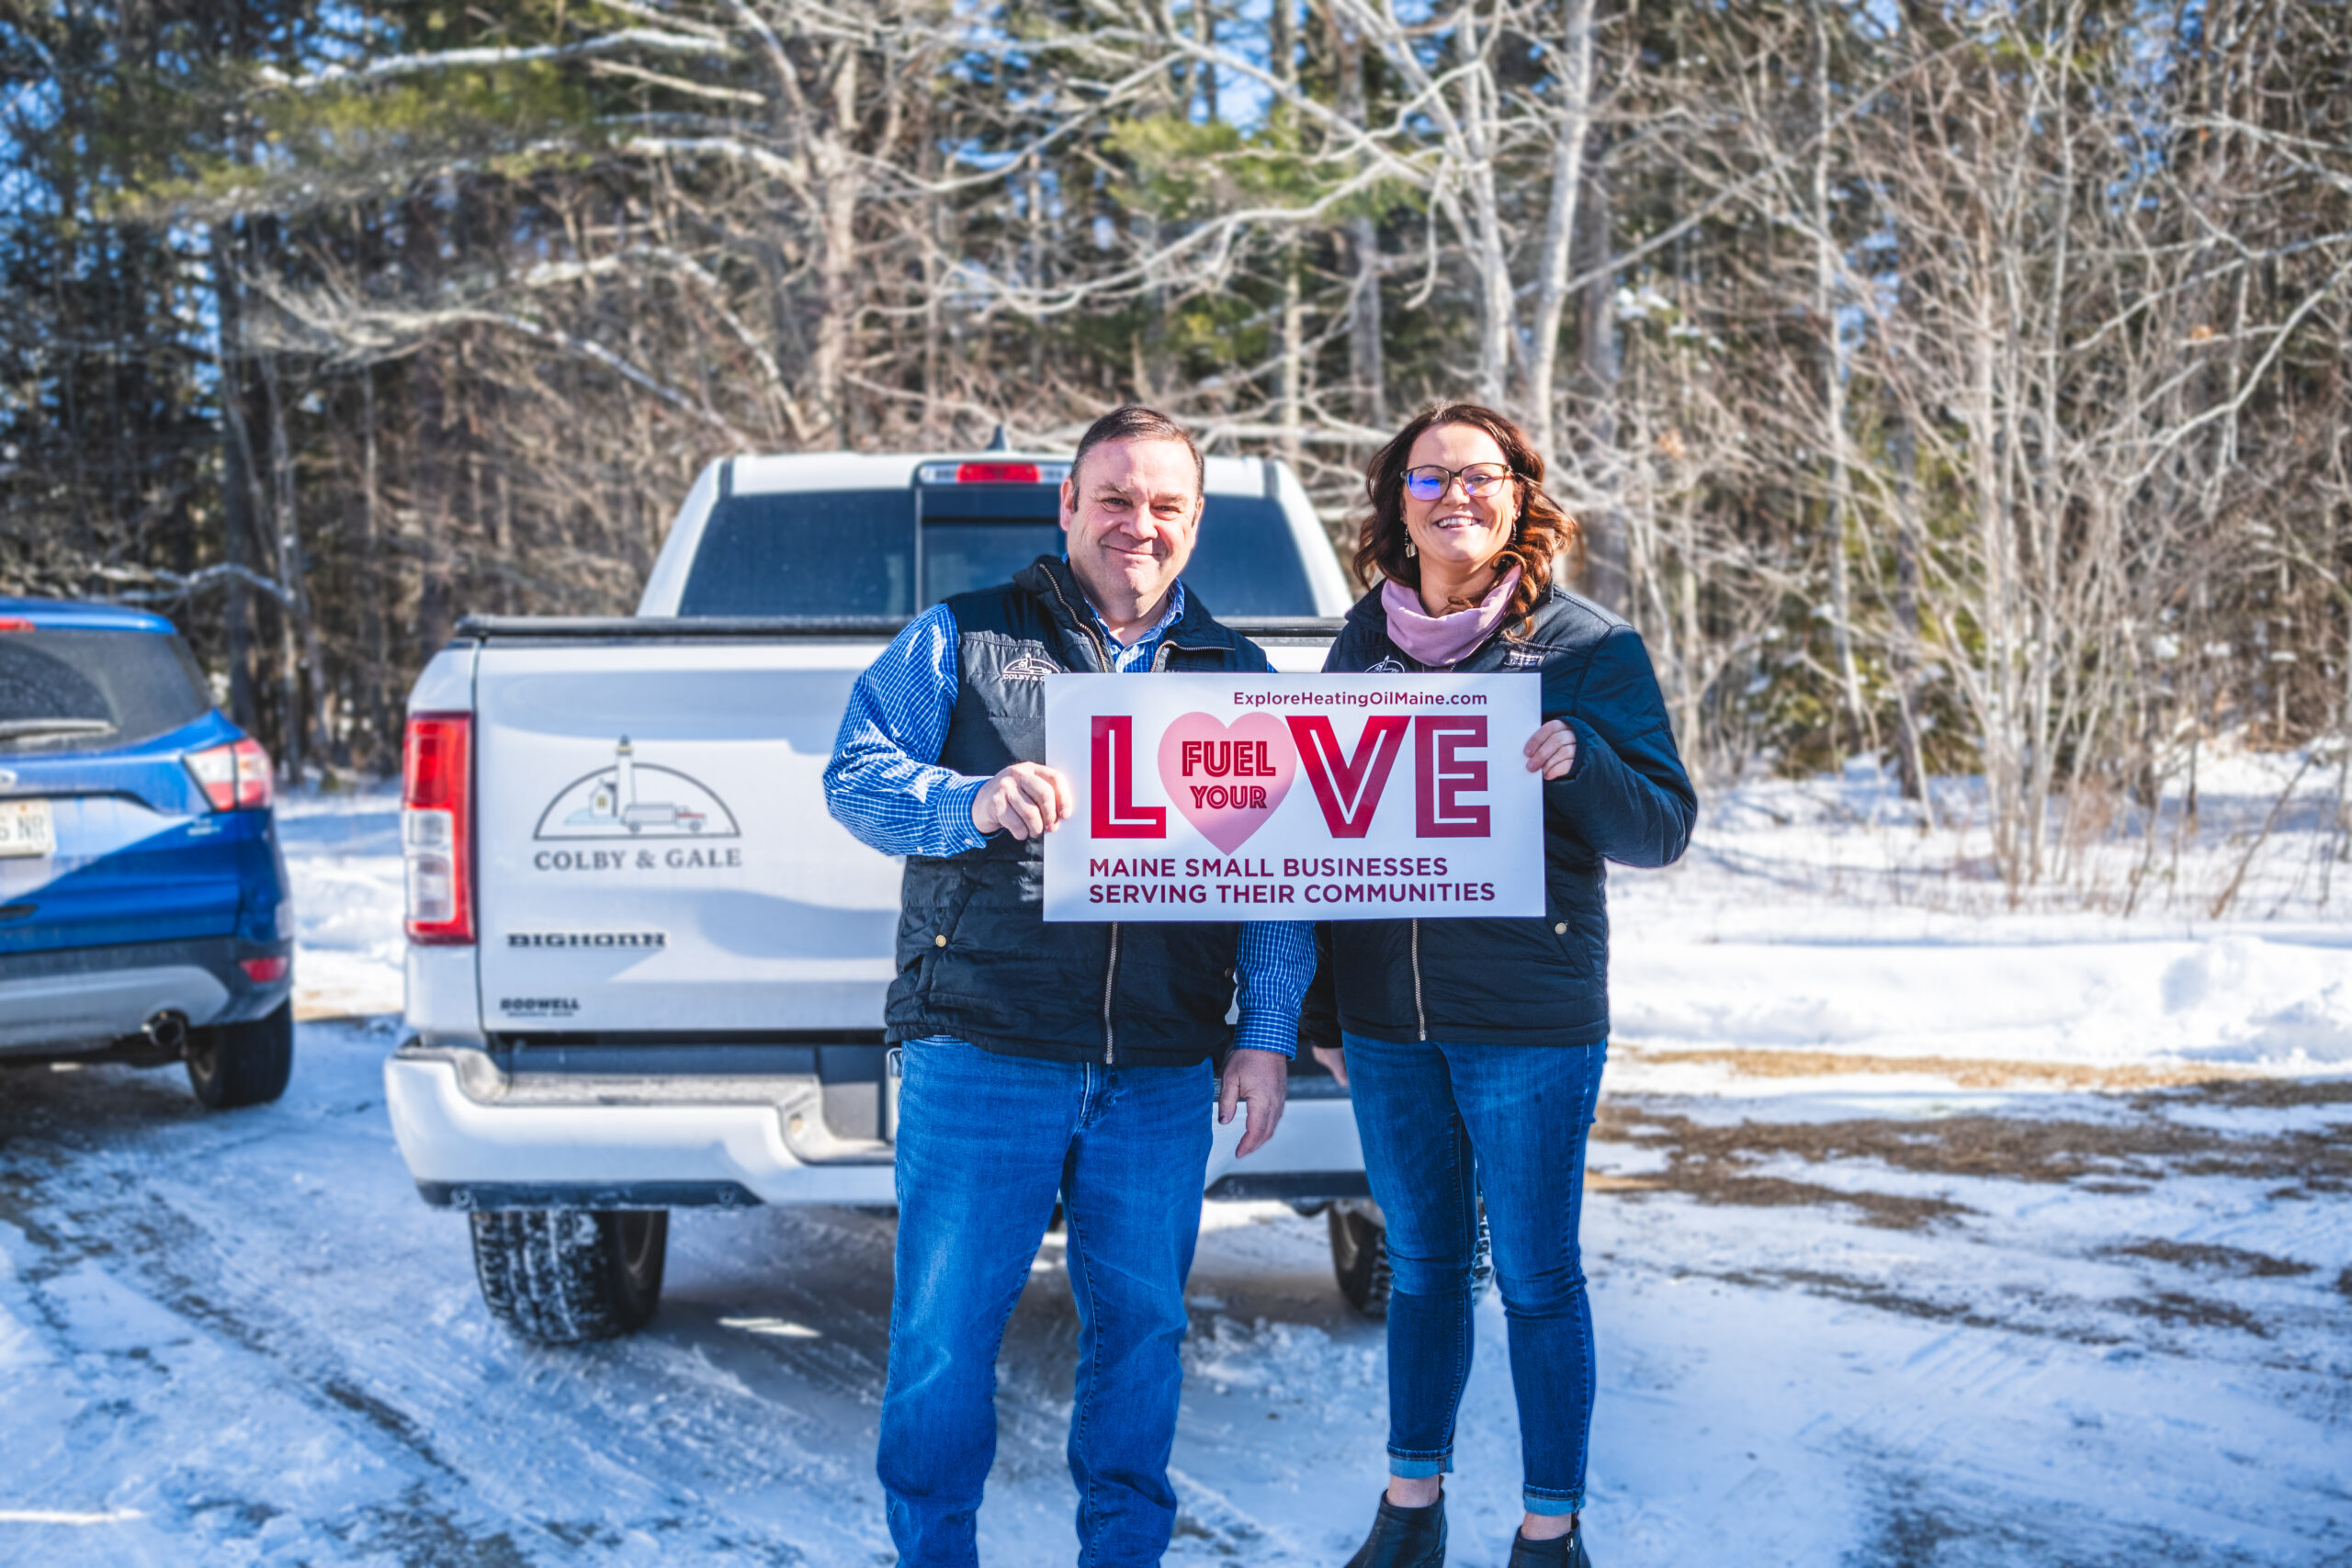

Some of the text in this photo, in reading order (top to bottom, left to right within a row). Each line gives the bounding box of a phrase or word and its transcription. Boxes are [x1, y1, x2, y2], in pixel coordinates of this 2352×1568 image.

[1234, 691, 1487, 706] ExploreHeatingOilMaine.com
[1182, 740, 1277, 777] FUEL
[1189, 784, 1268, 810] YOUR
[533, 847, 742, 872] COLBY & GALE
[1090, 857, 1448, 877] MAINE SMALL BUSINESSES
[1090, 883, 1496, 904] SERVING THEIR COMMUNITIES
[508, 932, 666, 948] BIGHORN
